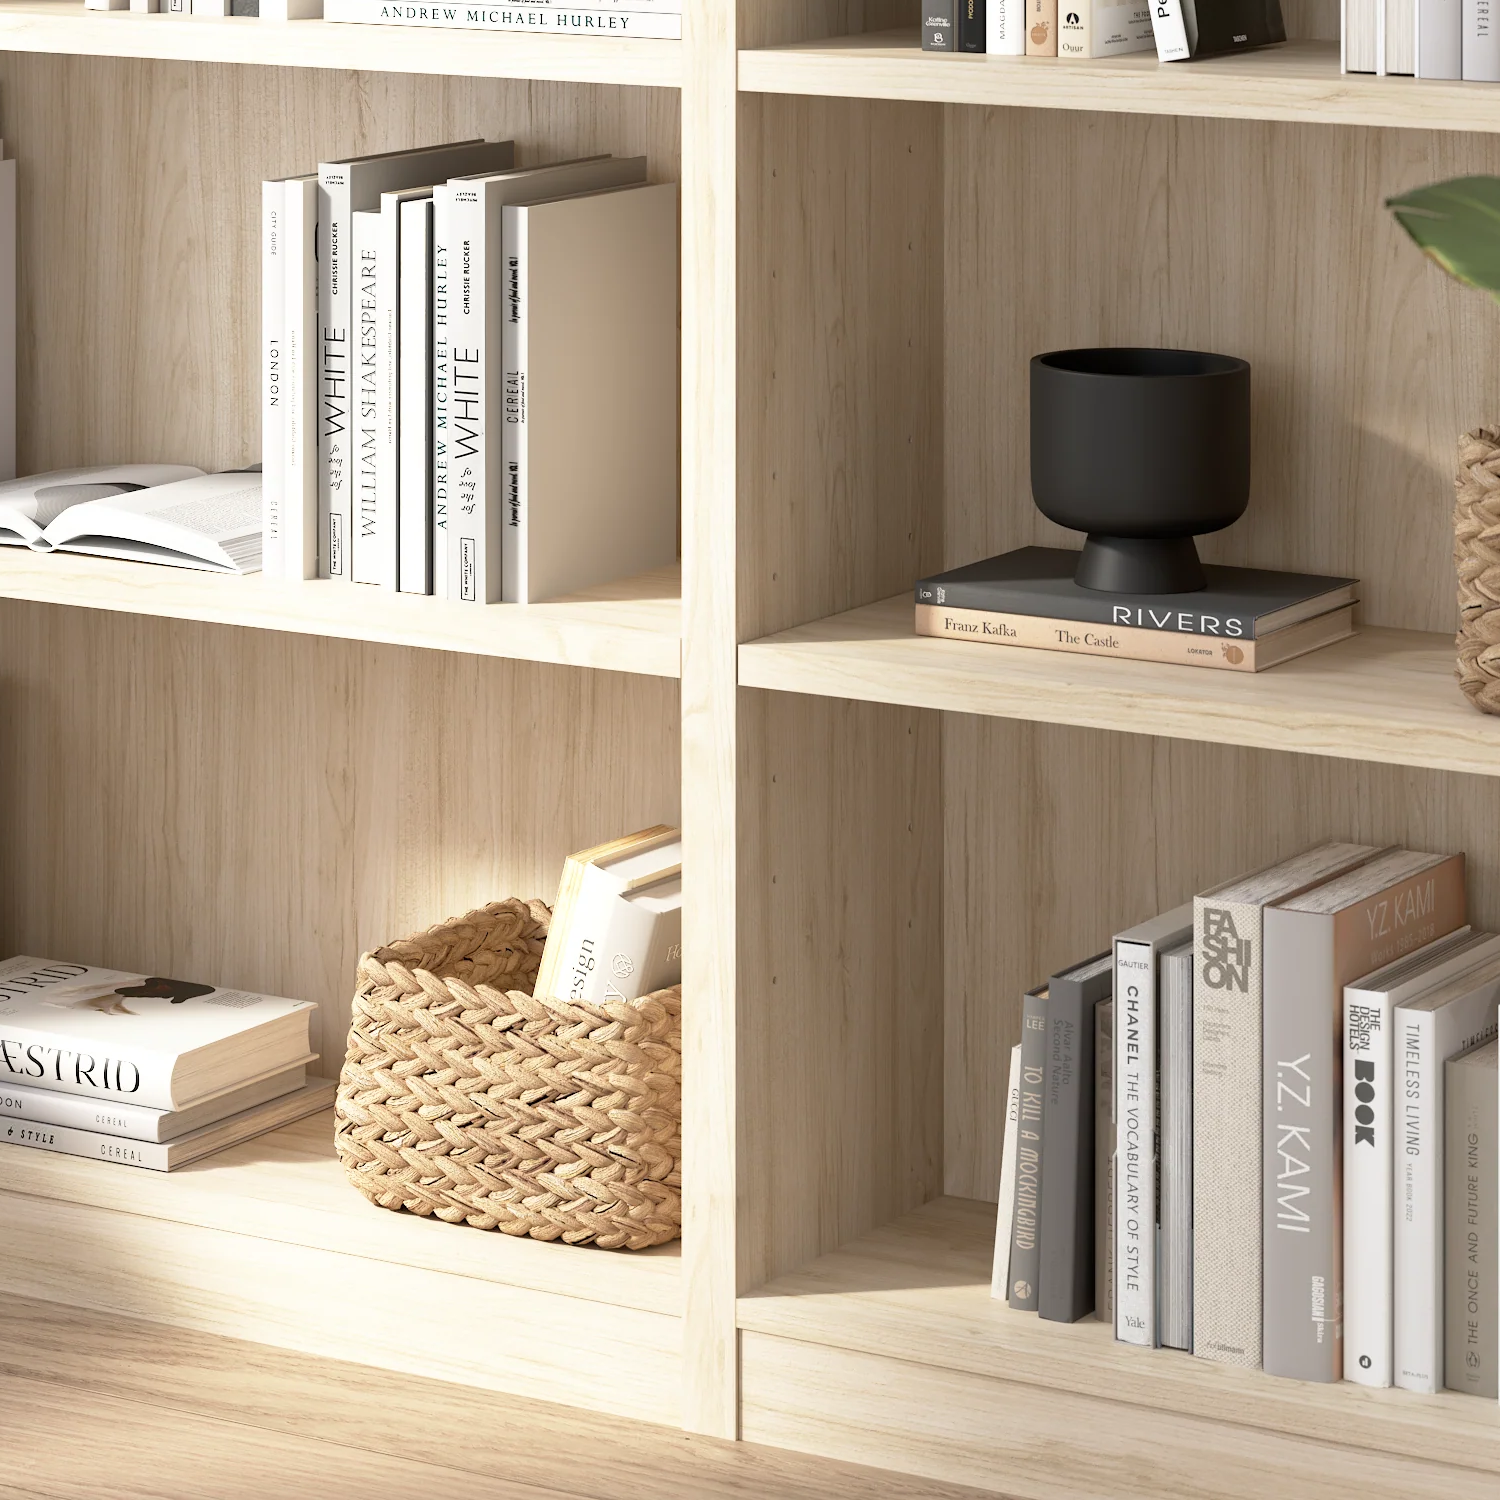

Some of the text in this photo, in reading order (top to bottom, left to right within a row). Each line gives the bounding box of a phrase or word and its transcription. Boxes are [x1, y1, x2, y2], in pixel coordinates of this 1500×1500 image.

[381, 7, 629, 29] ANDREW MICHAEL HURLEY
[325, 327, 345, 436] WHITE
[361, 249, 376, 538] WILLIAM SHAKESPEARE
[454, 347, 478, 459] WHITE
[944, 618, 1017, 638] Franz Kafka
[1056, 630, 1119, 649] The Castle
[1113, 604, 1243, 637] RIVERS
[1366, 878, 1436, 941] Y.Z. KAMI
[1118, 959, 1148, 970] GAUTIER
[1360, 1006, 1370, 1051] DESIGN
[1370, 1008, 1380, 1031] THE
[1010, 1087, 1019, 1121] GUCCI
[1354, 1060, 1376, 1148] BOOK
[1406, 1024, 1420, 1156] TIMELESS LIVING
[7, 1126, 14, 1136] &
[20, 1130, 54, 1144] STYLE
[101, 1144, 142, 1162] CEREAL
[1017, 1065, 1042, 1250] TO KILL A MOCKINGBIRD
[1126, 984, 1140, 1292] CHANEL THE VOCABULARY OF STYLE
[1277, 1054, 1311, 1233] Y.Z. KAMI
[1468, 1133, 1478, 1345] THE ONCE AND FUTURE KING
